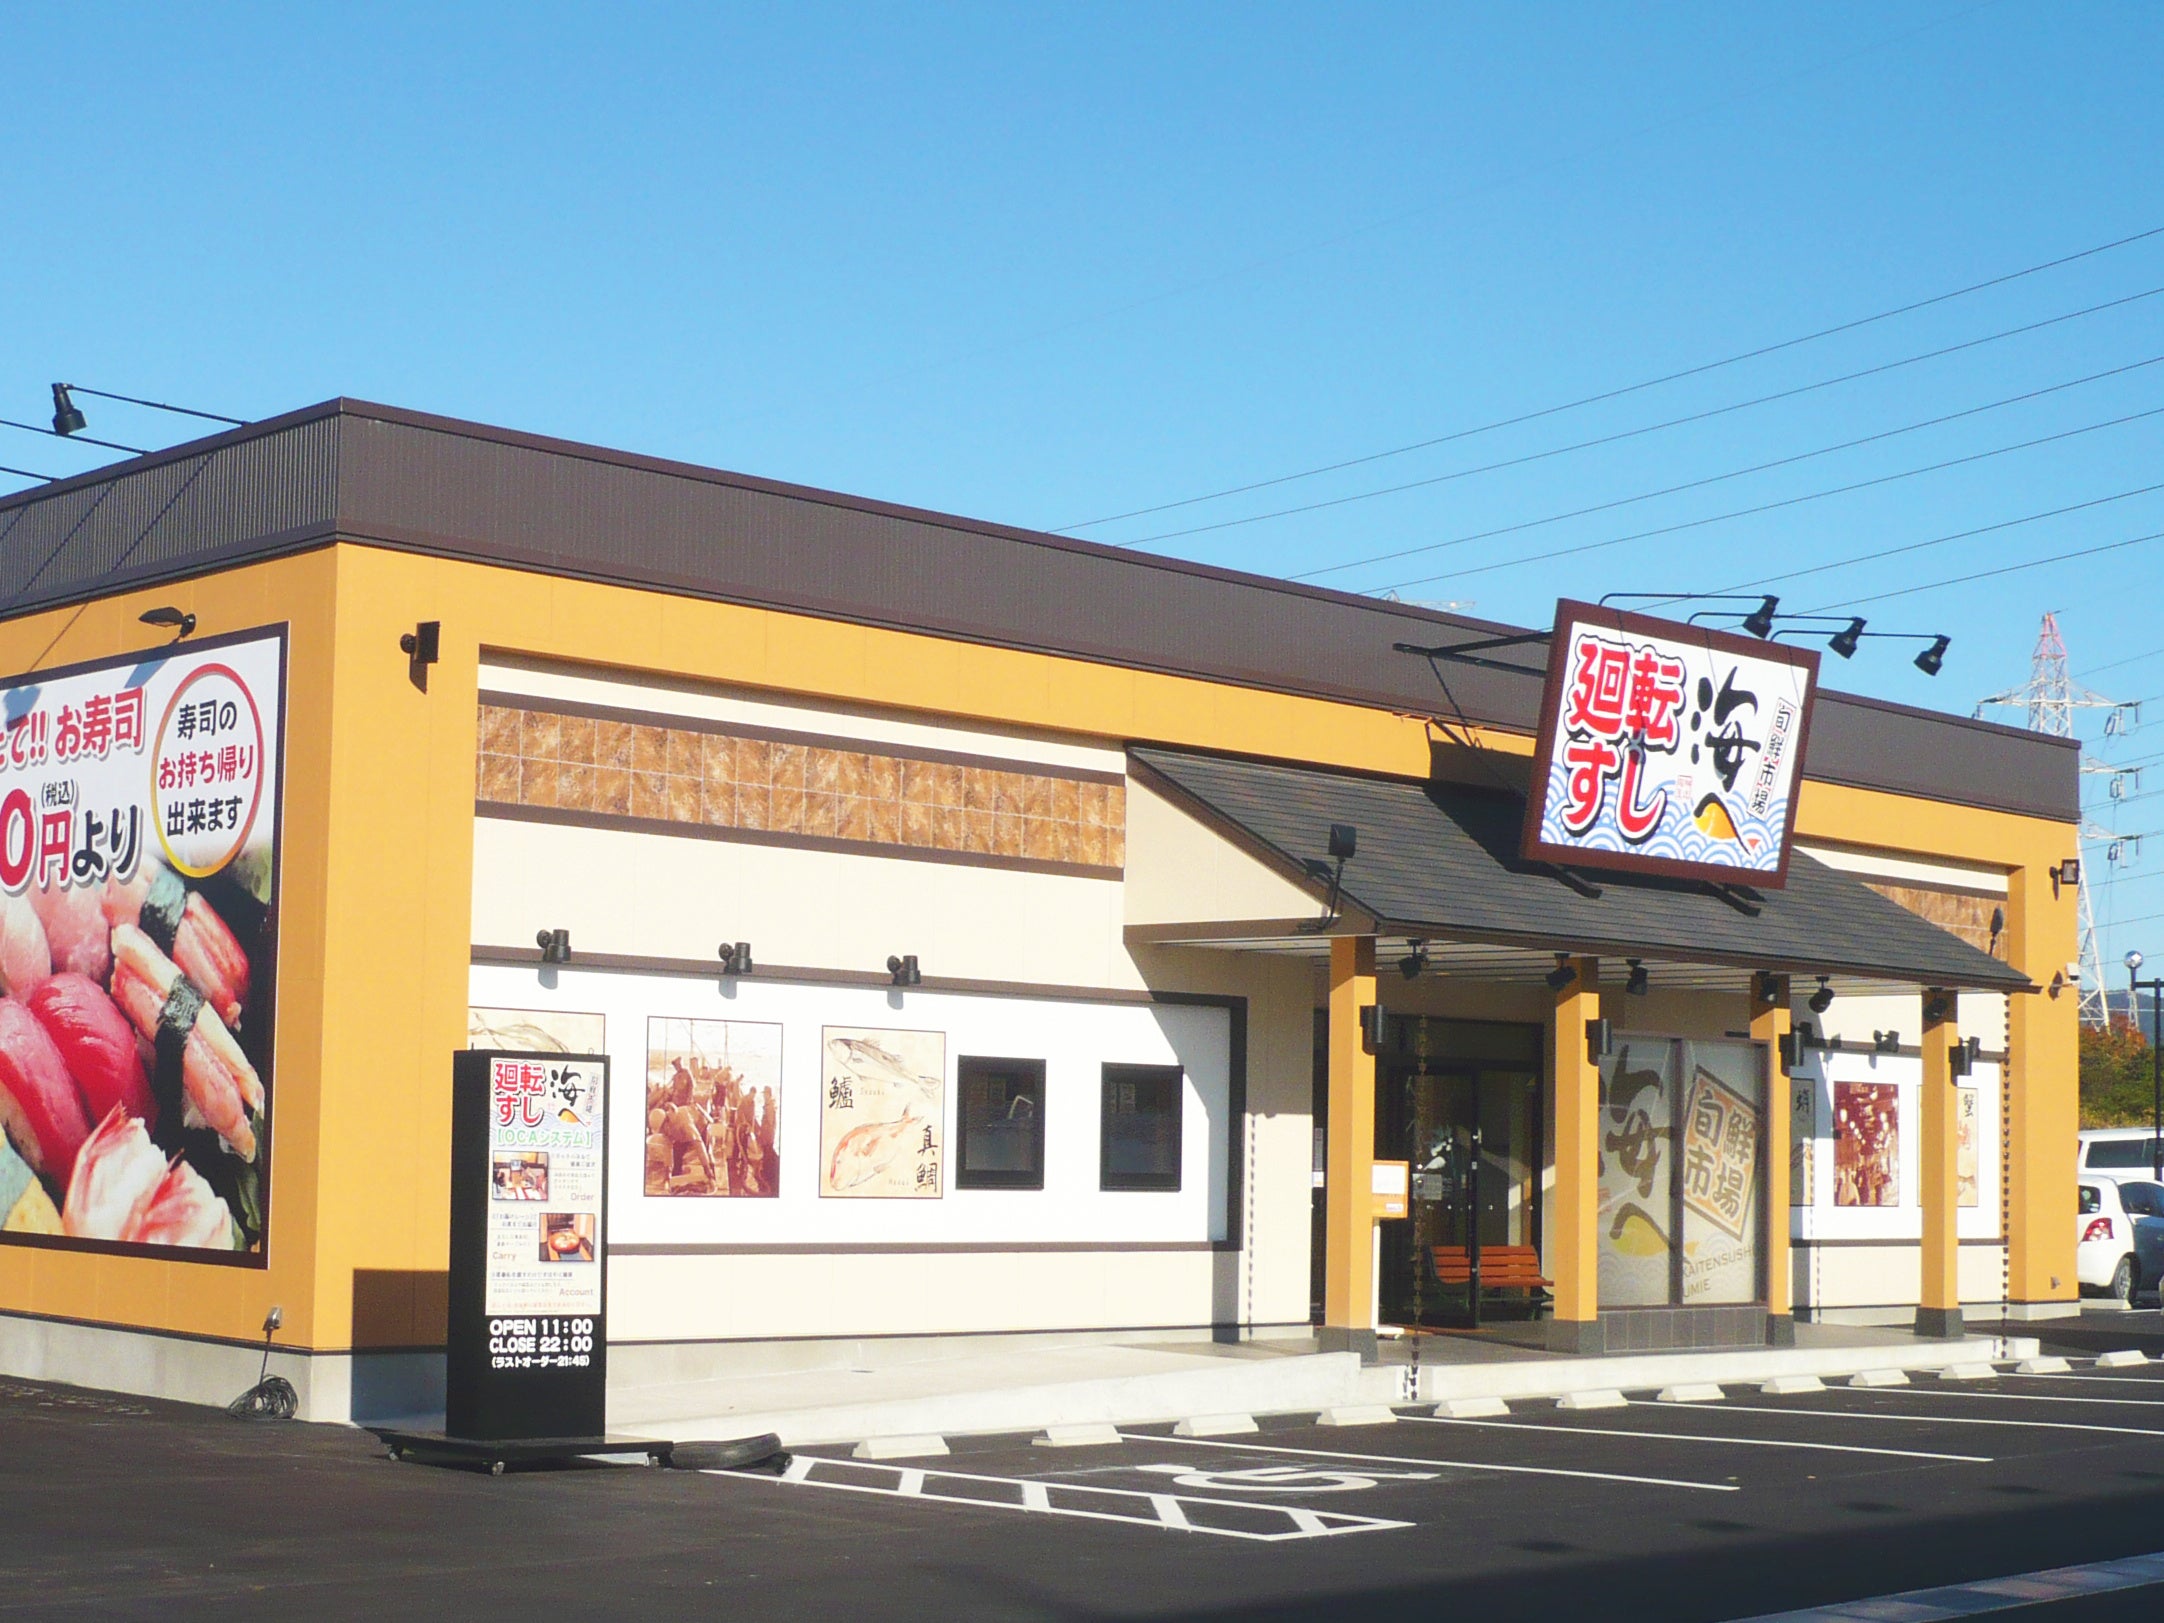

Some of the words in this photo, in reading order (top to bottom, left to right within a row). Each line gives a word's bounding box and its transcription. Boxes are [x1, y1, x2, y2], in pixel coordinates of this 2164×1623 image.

[1568, 642, 1681, 745] 廻転
[0, 711, 46, 766] て!!
[55, 687, 144, 757] お寿司
[177, 699, 237, 741] 寿司の
[159, 744, 255, 790] お持ち帰り
[41, 779, 74, 808] (税込)
[1566, 741, 1662, 833] すし
[167, 795, 243, 837] 出来ます
[495, 1062, 543, 1093] 廻転
[495, 1095, 542, 1124] すし
[570, 1192, 594, 1201] Order
[492, 1251, 516, 1262] Carry
[559, 1288, 594, 1296] Account
[489, 1318, 537, 1336] OPEN
[541, 1318, 594, 1335] 11:00
[489, 1336, 536, 1354] CLOSE
[539, 1336, 593, 1353] 22:00
